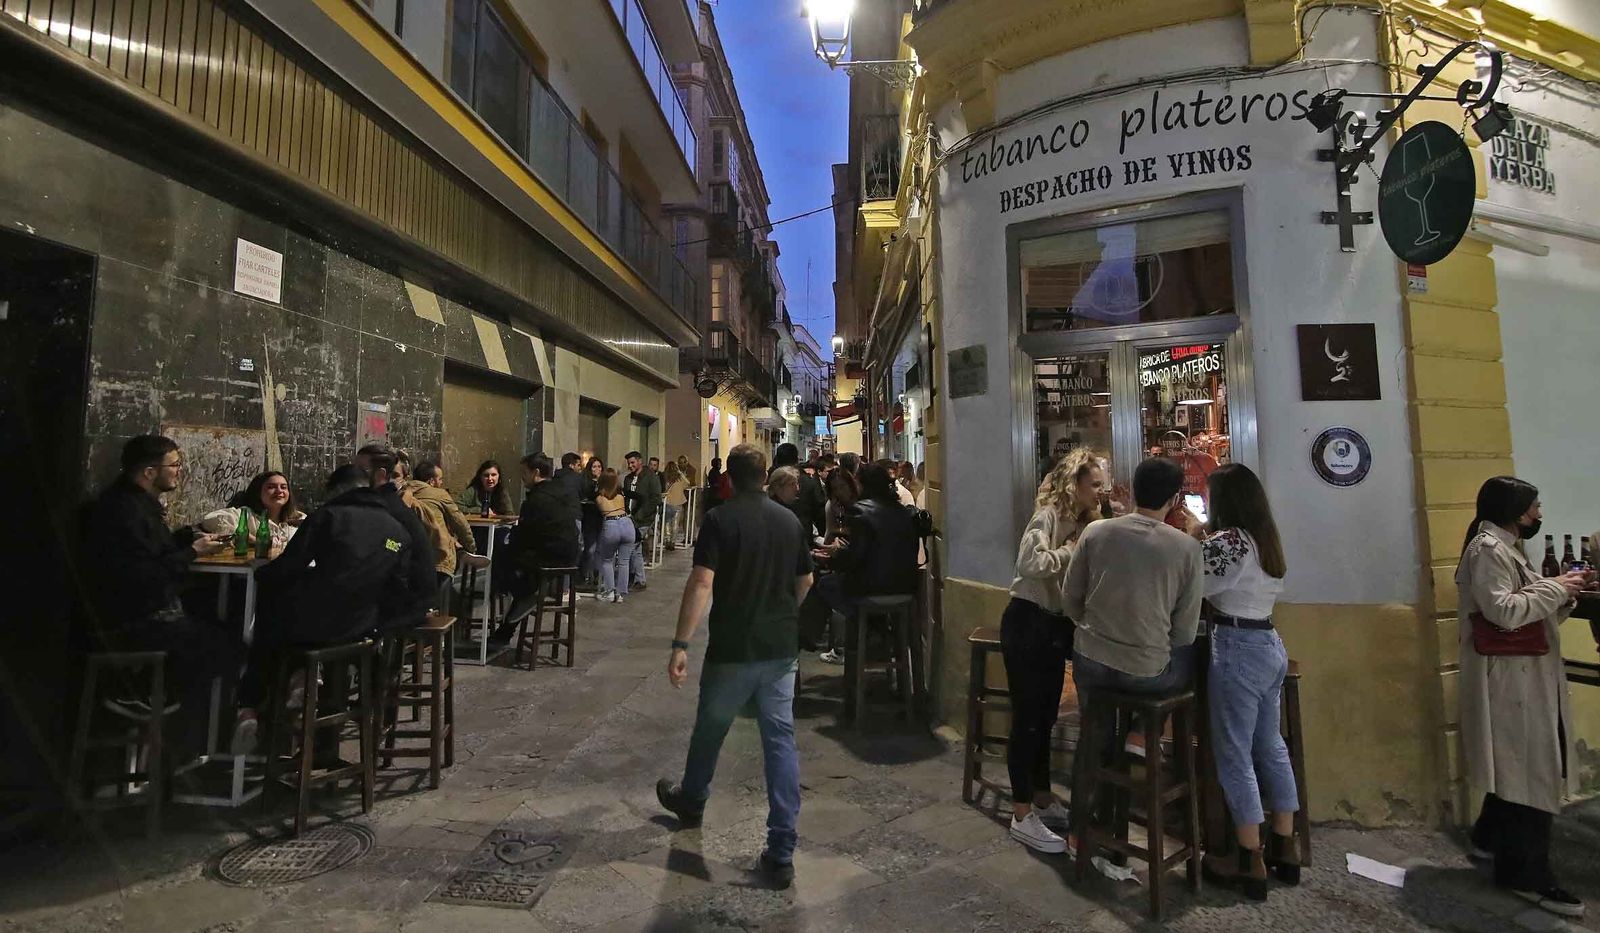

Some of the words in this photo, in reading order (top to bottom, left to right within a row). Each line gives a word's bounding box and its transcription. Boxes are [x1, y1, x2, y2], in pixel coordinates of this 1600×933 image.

[960, 119, 1090, 184] tabanco
[1119, 89, 1310, 154] plateros
[1500, 117, 1551, 151] AZA
[1000, 164, 1113, 213] DESPACHO
[1123, 156, 1158, 186] DE
[1167, 144, 1253, 179] VINOS
[1490, 157, 1556, 195] YERBA
[254, 261, 281, 278] CARTELES
[1139, 353, 1161, 370] BRICA
[1171, 353, 1220, 379] PLATEROS
[1156, 387, 1209, 402] PATEROS
